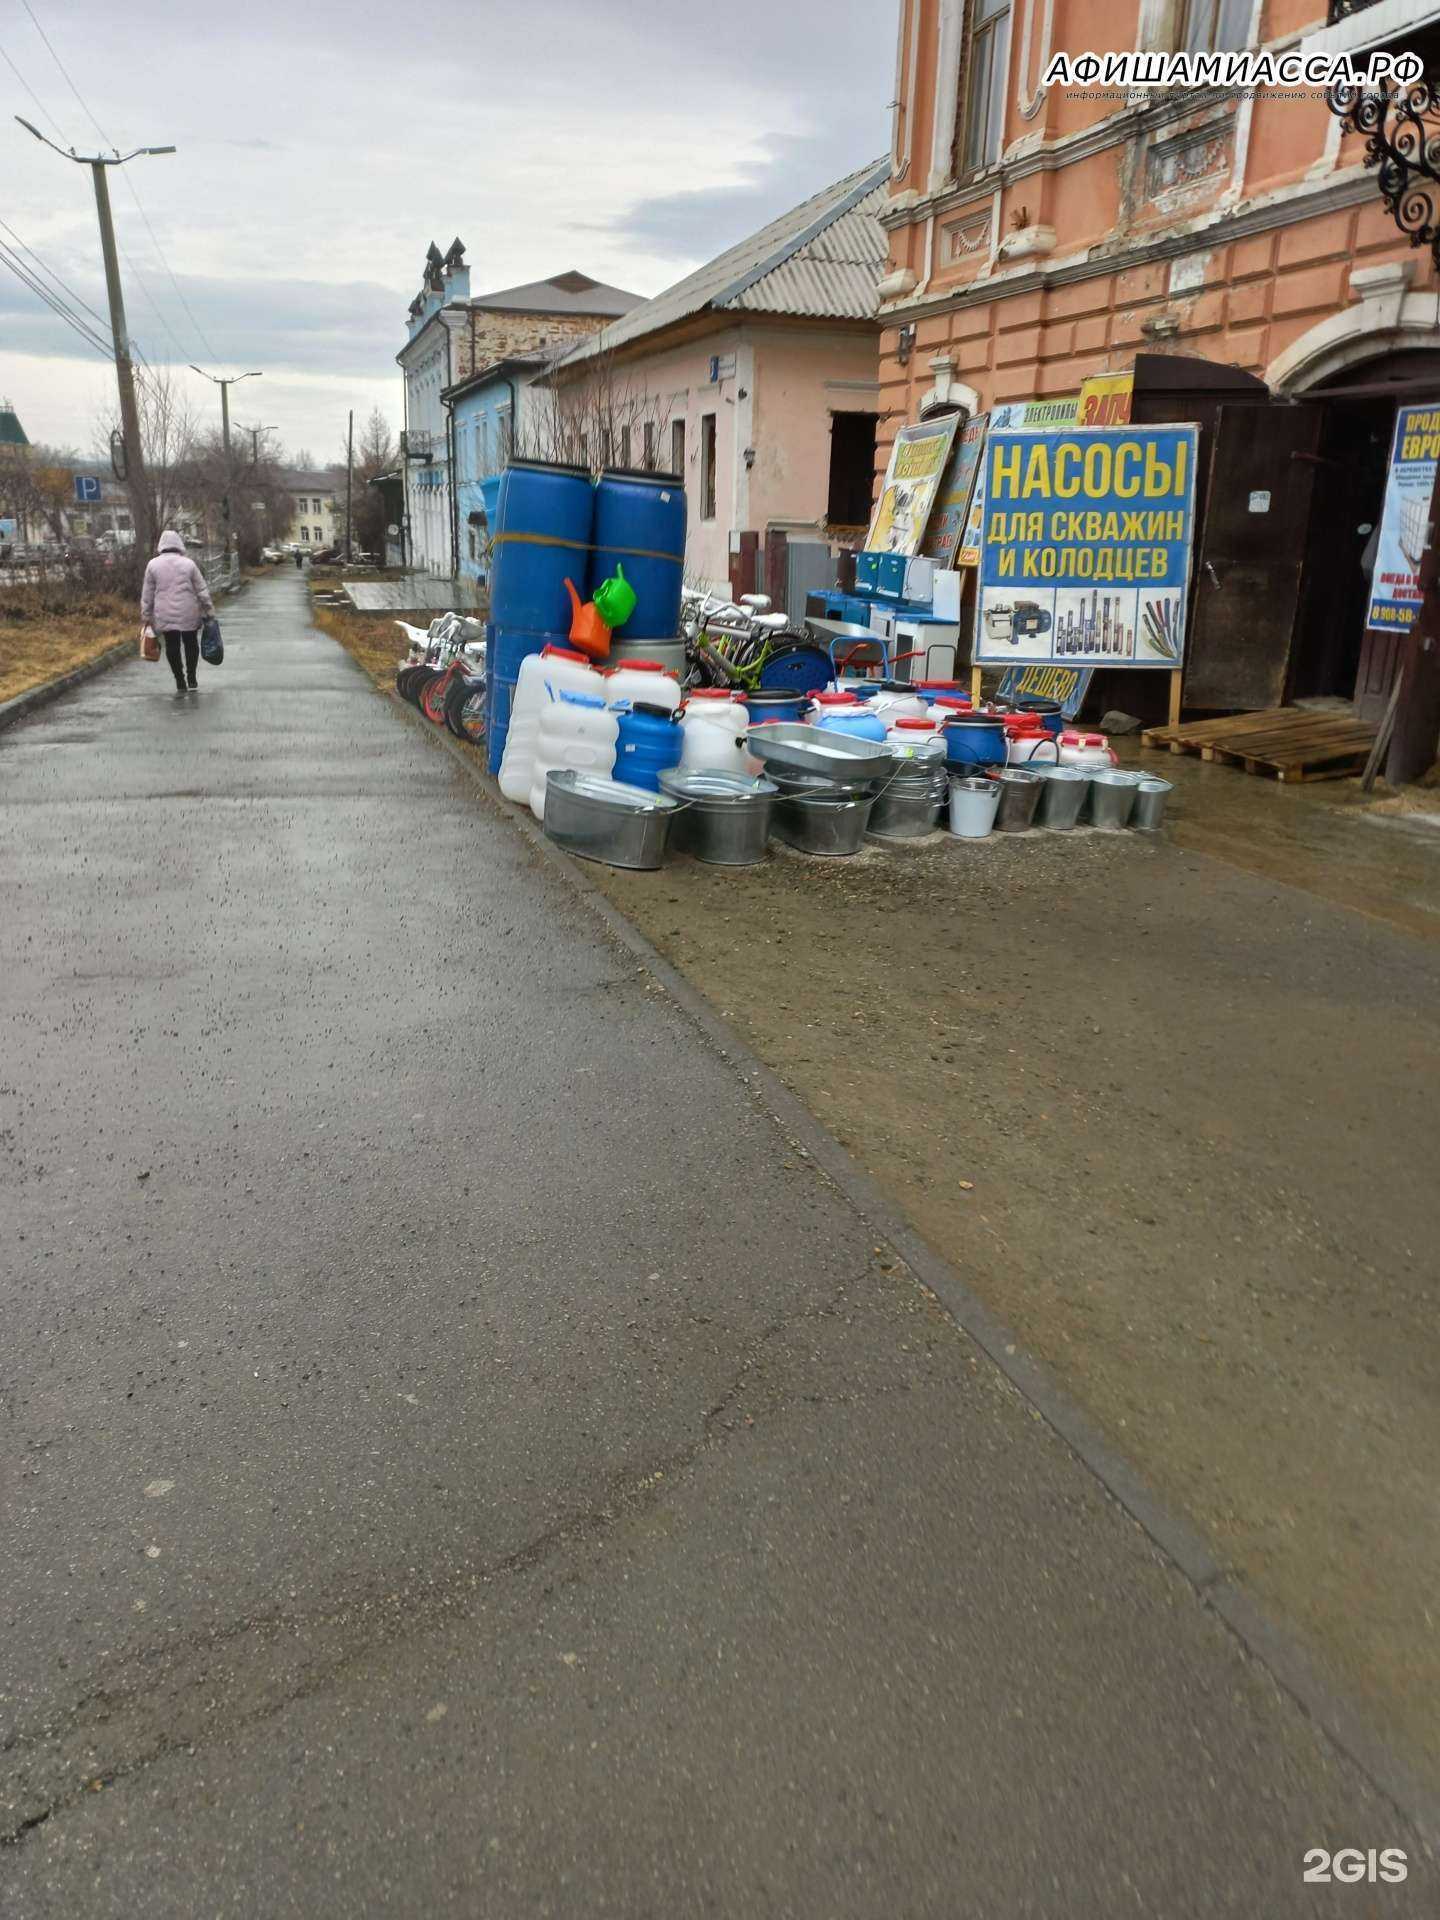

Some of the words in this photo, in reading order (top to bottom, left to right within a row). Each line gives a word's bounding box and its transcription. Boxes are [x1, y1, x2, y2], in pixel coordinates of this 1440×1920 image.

[991, 440, 1188, 499] НАСОСЫ
[987, 511, 1044, 545] ДЛЯ
[1051, 510, 1184, 542] СКВАЖИН
[998, 548, 1016, 577] И
[1023, 546, 1168, 581] КОЛОДЦЕВ
[1015, 666, 1079, 702] ДЕШЕВО
